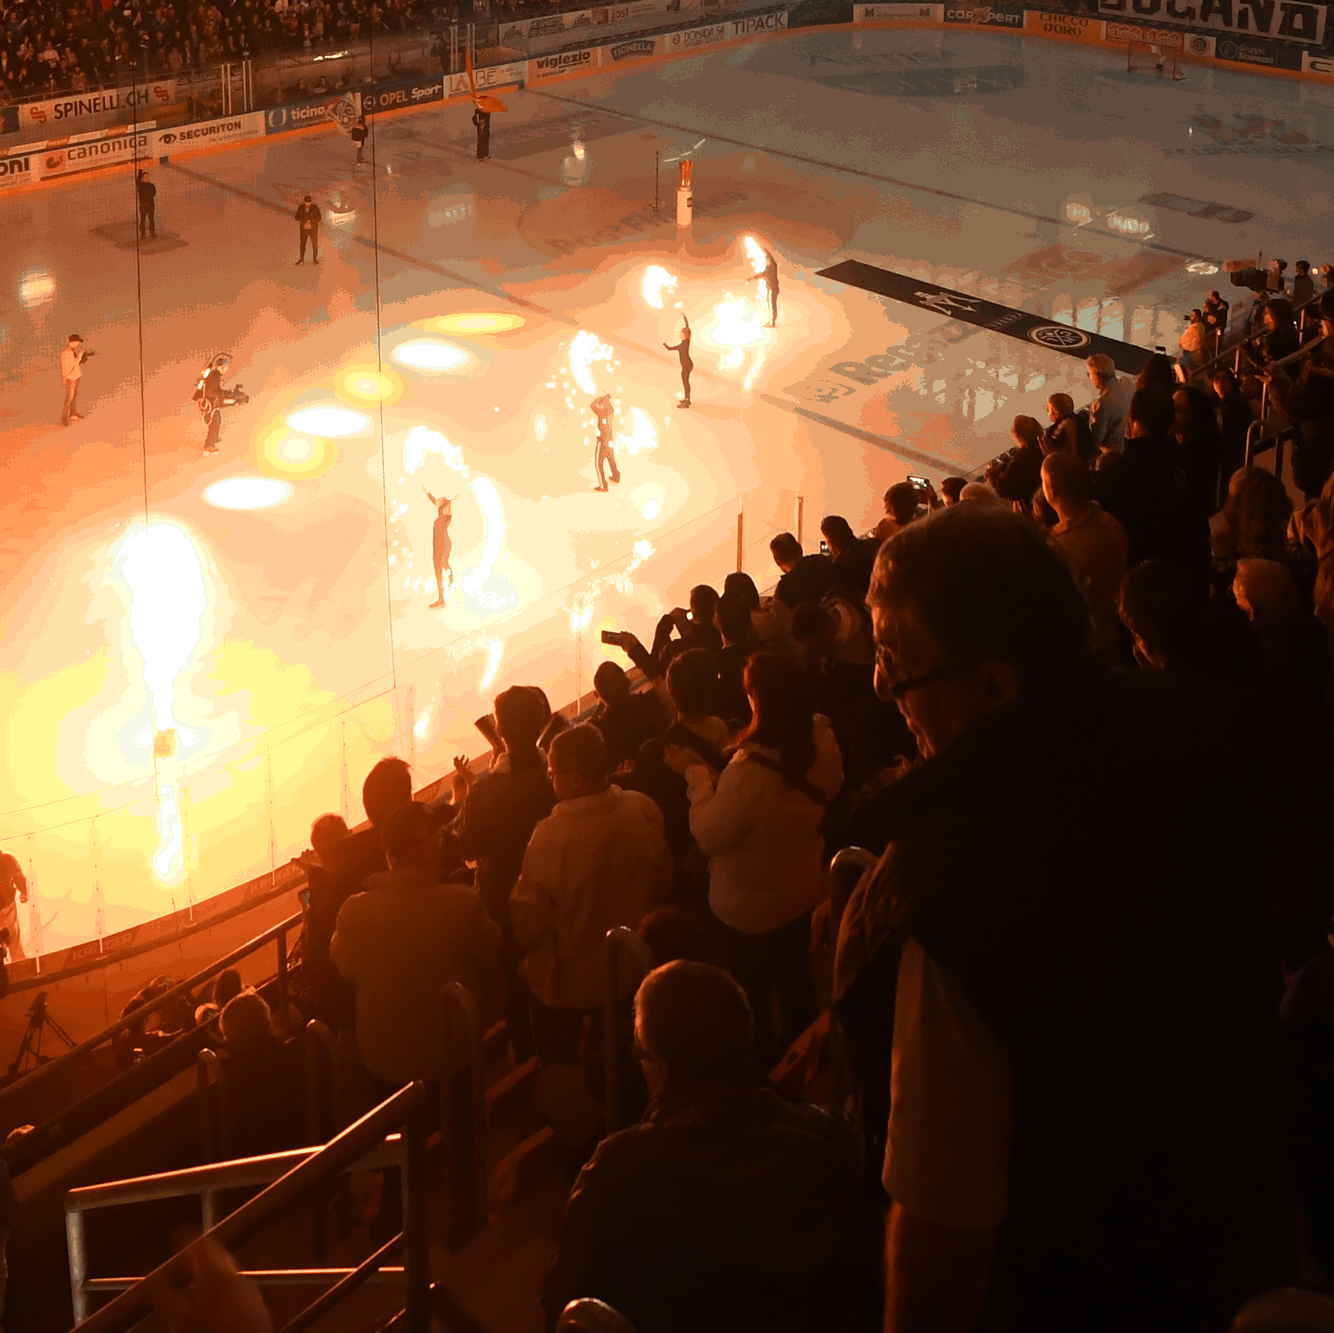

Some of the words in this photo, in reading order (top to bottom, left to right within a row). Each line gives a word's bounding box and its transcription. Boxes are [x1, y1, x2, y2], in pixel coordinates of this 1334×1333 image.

[731, 13, 785, 35] TIPACK
[1039, 12, 1089, 28] CHICCO
[1043, 23, 1082, 37] D'ORO
[536, 50, 591, 70] viglezio
[379, 90, 408, 107] OPEL
[411, 82, 443, 100] Sport
[290, 105, 325, 122] ticino
[178, 120, 242, 142] SECURITON
[66, 134, 148, 162] canonica
